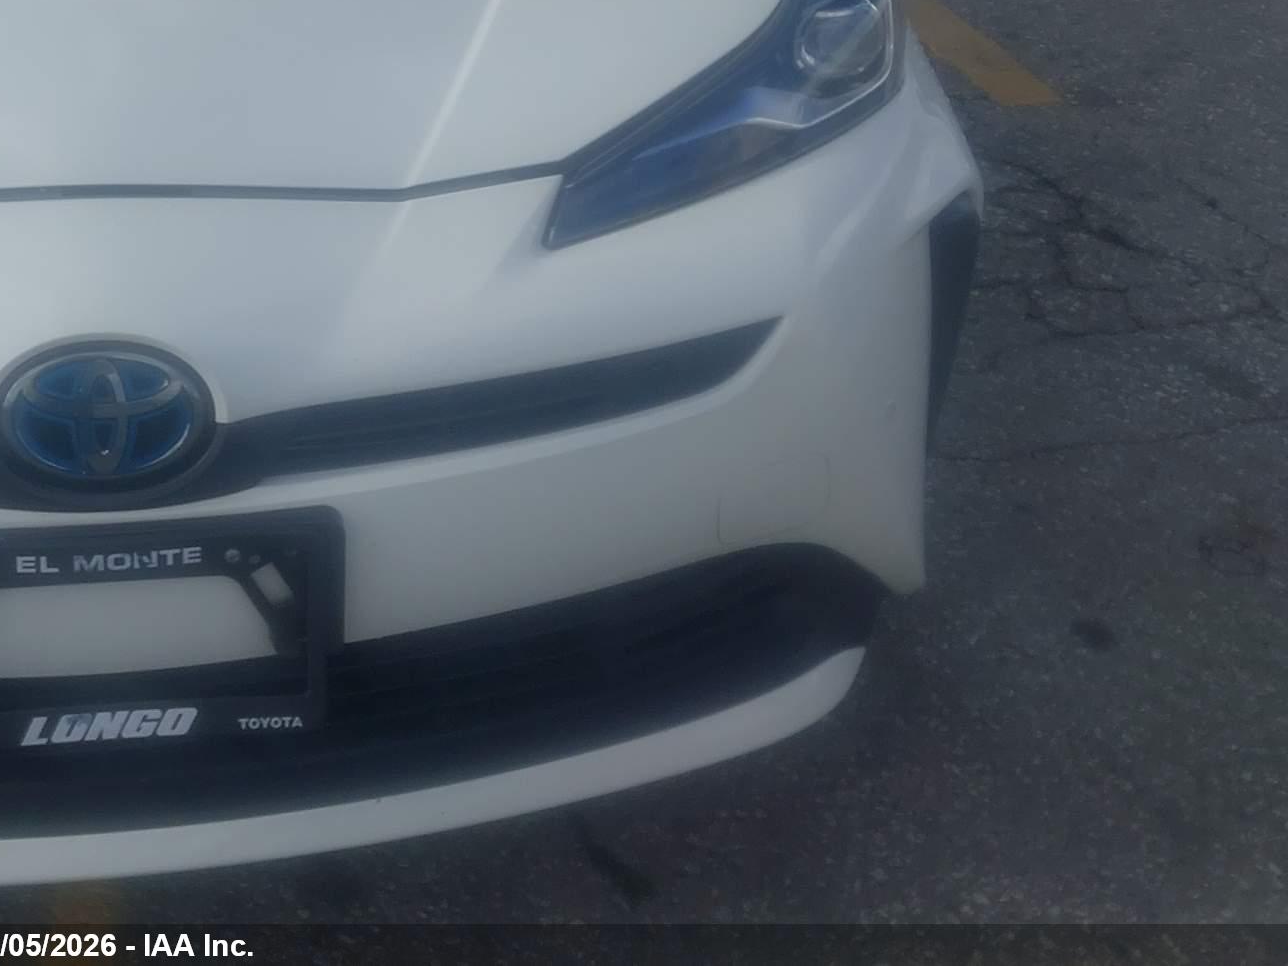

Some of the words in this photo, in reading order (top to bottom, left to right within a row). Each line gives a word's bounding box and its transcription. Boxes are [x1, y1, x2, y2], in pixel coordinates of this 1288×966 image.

[16, 555, 59, 573] EL
[73, 547, 202, 572] MONTE
[20, 706, 198, 747] LONGO
[237, 715, 303, 732] TOYOTA
